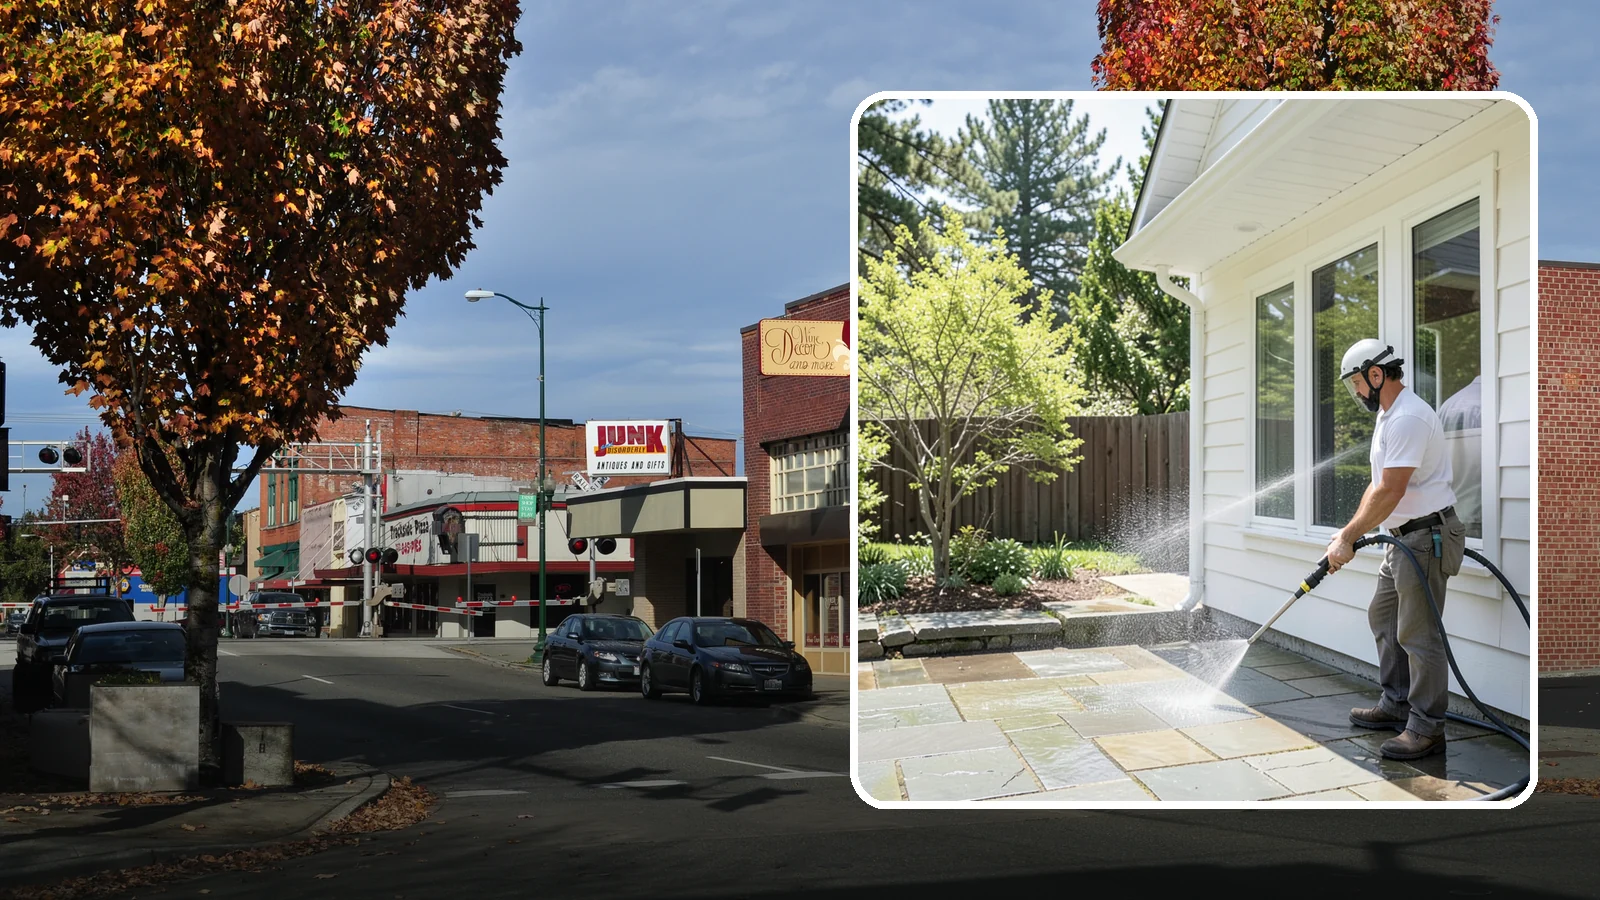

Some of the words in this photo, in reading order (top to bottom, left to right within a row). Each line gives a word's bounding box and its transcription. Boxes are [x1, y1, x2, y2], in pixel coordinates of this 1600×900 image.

[596, 425, 665, 457] JUNK
[608, 446, 646, 454] DISORDERLY
[597, 461, 628, 470] ANTIQUES
[631, 461, 643, 470] AND
[647, 460, 666, 469] GIFTS
[590, 476, 608, 492] SING
[352, 498, 365, 511] CRO
[390, 521, 413, 540] Trackside
[414, 519, 429, 535] Pizza
